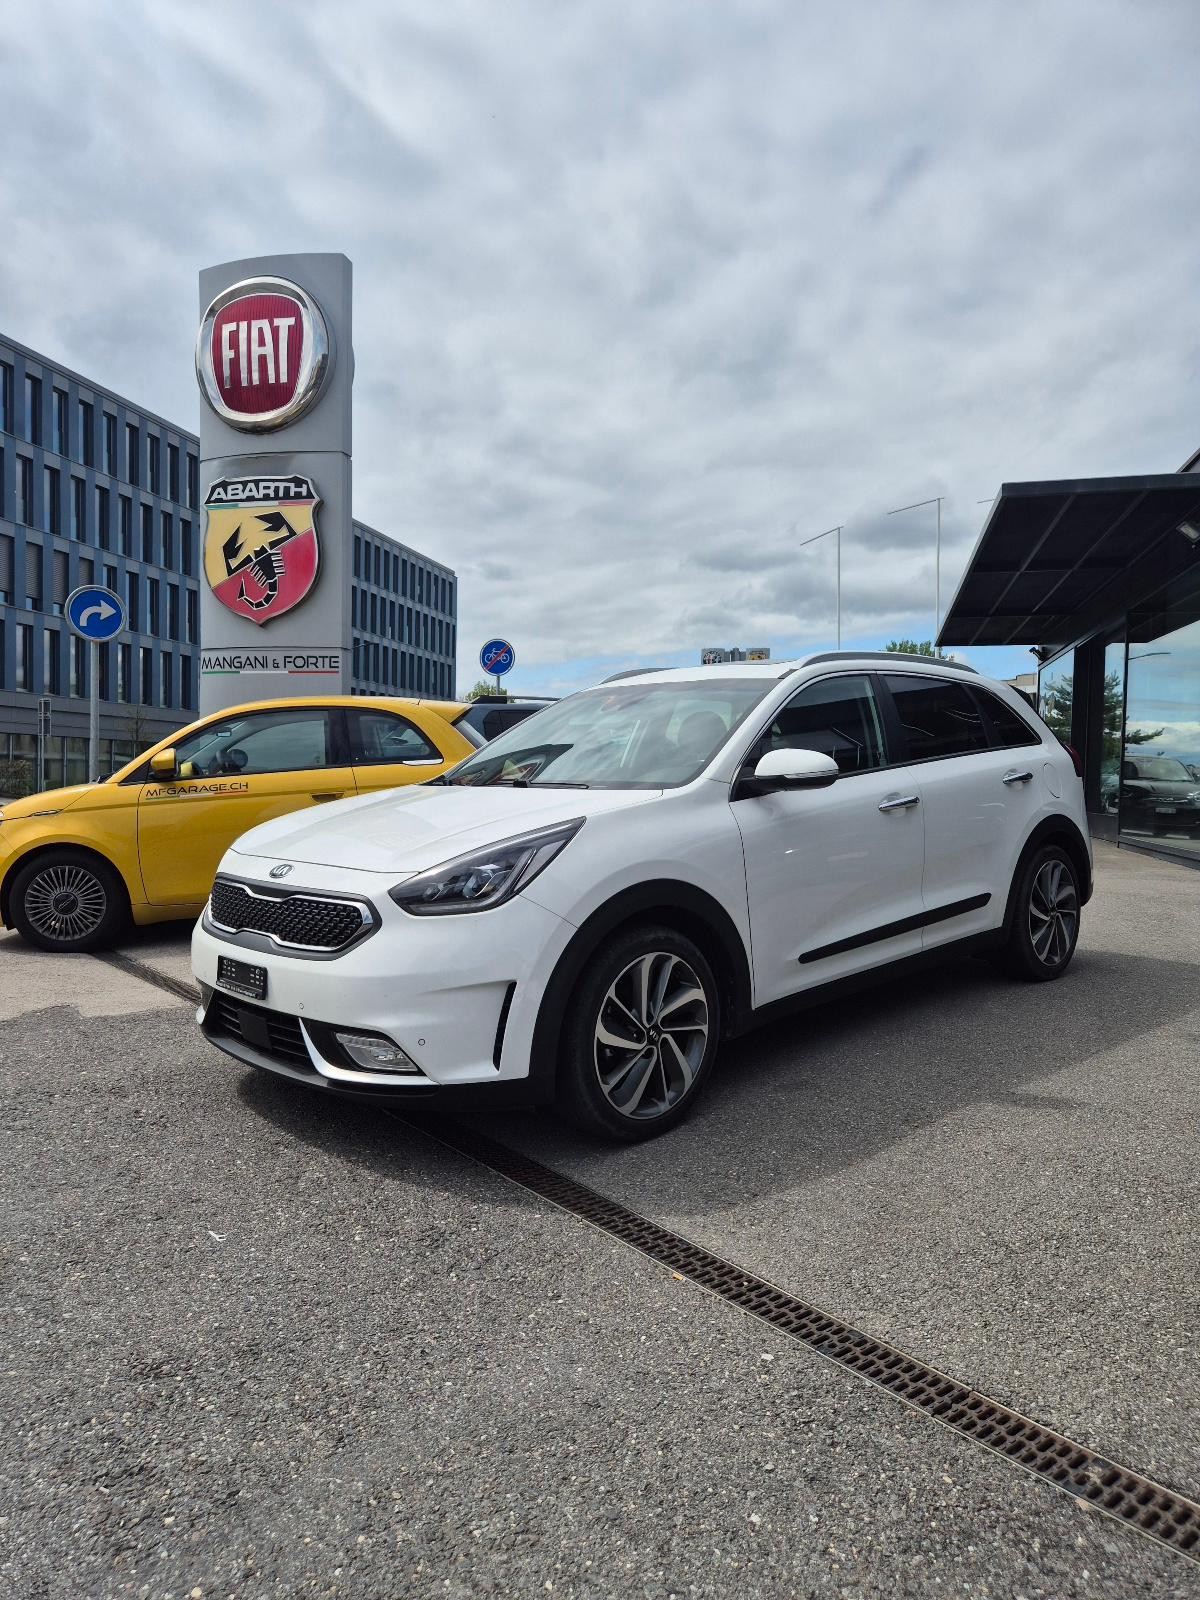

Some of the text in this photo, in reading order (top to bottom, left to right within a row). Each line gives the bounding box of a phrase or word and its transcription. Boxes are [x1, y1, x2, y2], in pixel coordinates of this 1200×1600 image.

[221, 316, 296, 389] FIAT
[210, 481, 308, 501] ABARTH
[201, 655, 340, 670] MANGANI & FORTE
[145, 781, 249, 797] MFGARAGE.CH
